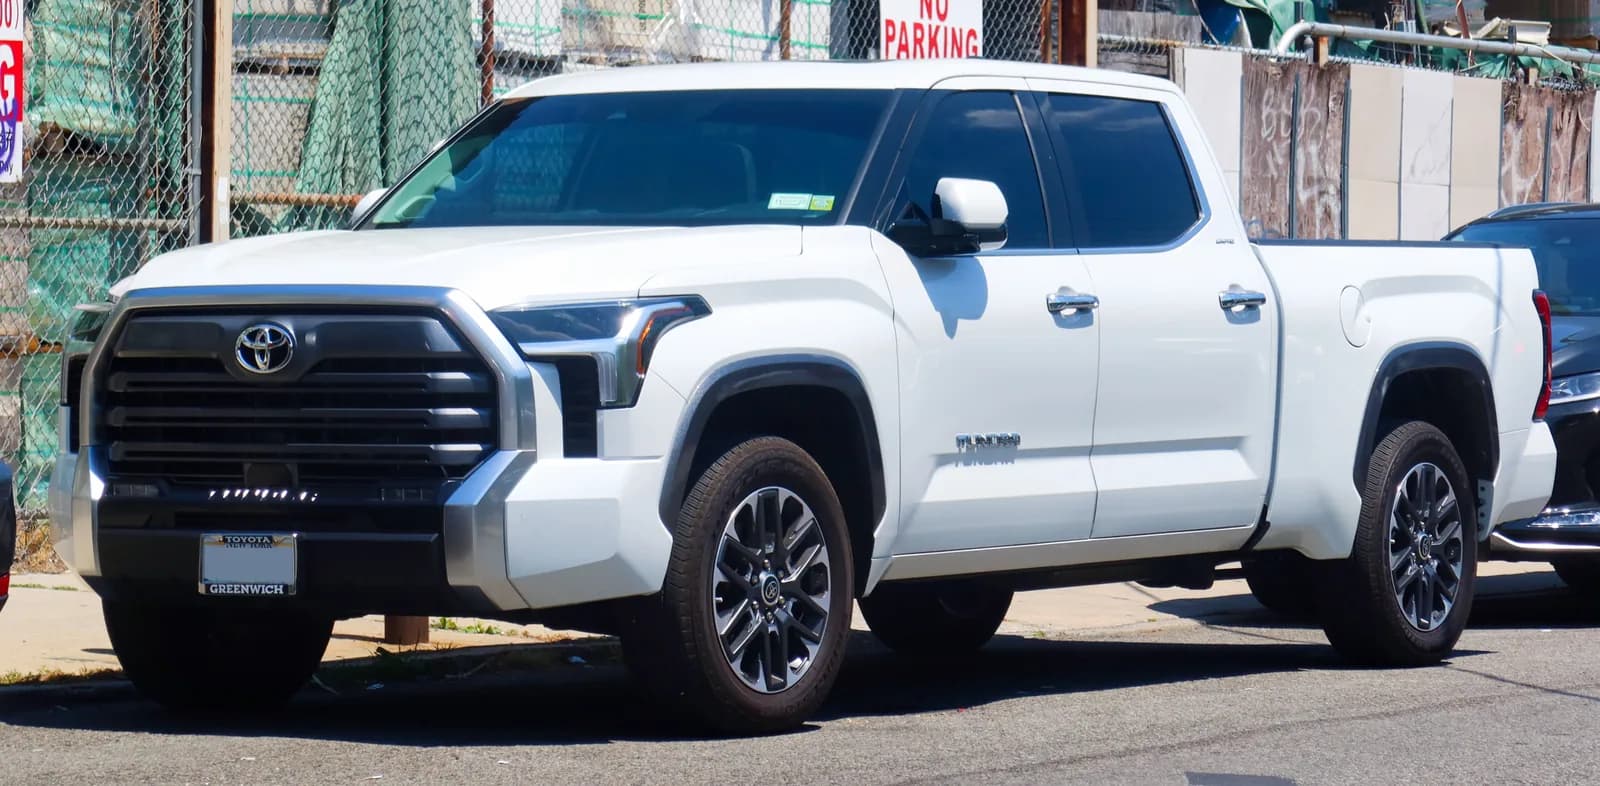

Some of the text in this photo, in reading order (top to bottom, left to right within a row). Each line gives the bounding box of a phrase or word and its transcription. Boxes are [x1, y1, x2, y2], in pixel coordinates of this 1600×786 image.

[920, 0, 948, 21] NO
[885, 19, 978, 60] PARKING
[209, 584, 284, 594] GREENWICH
